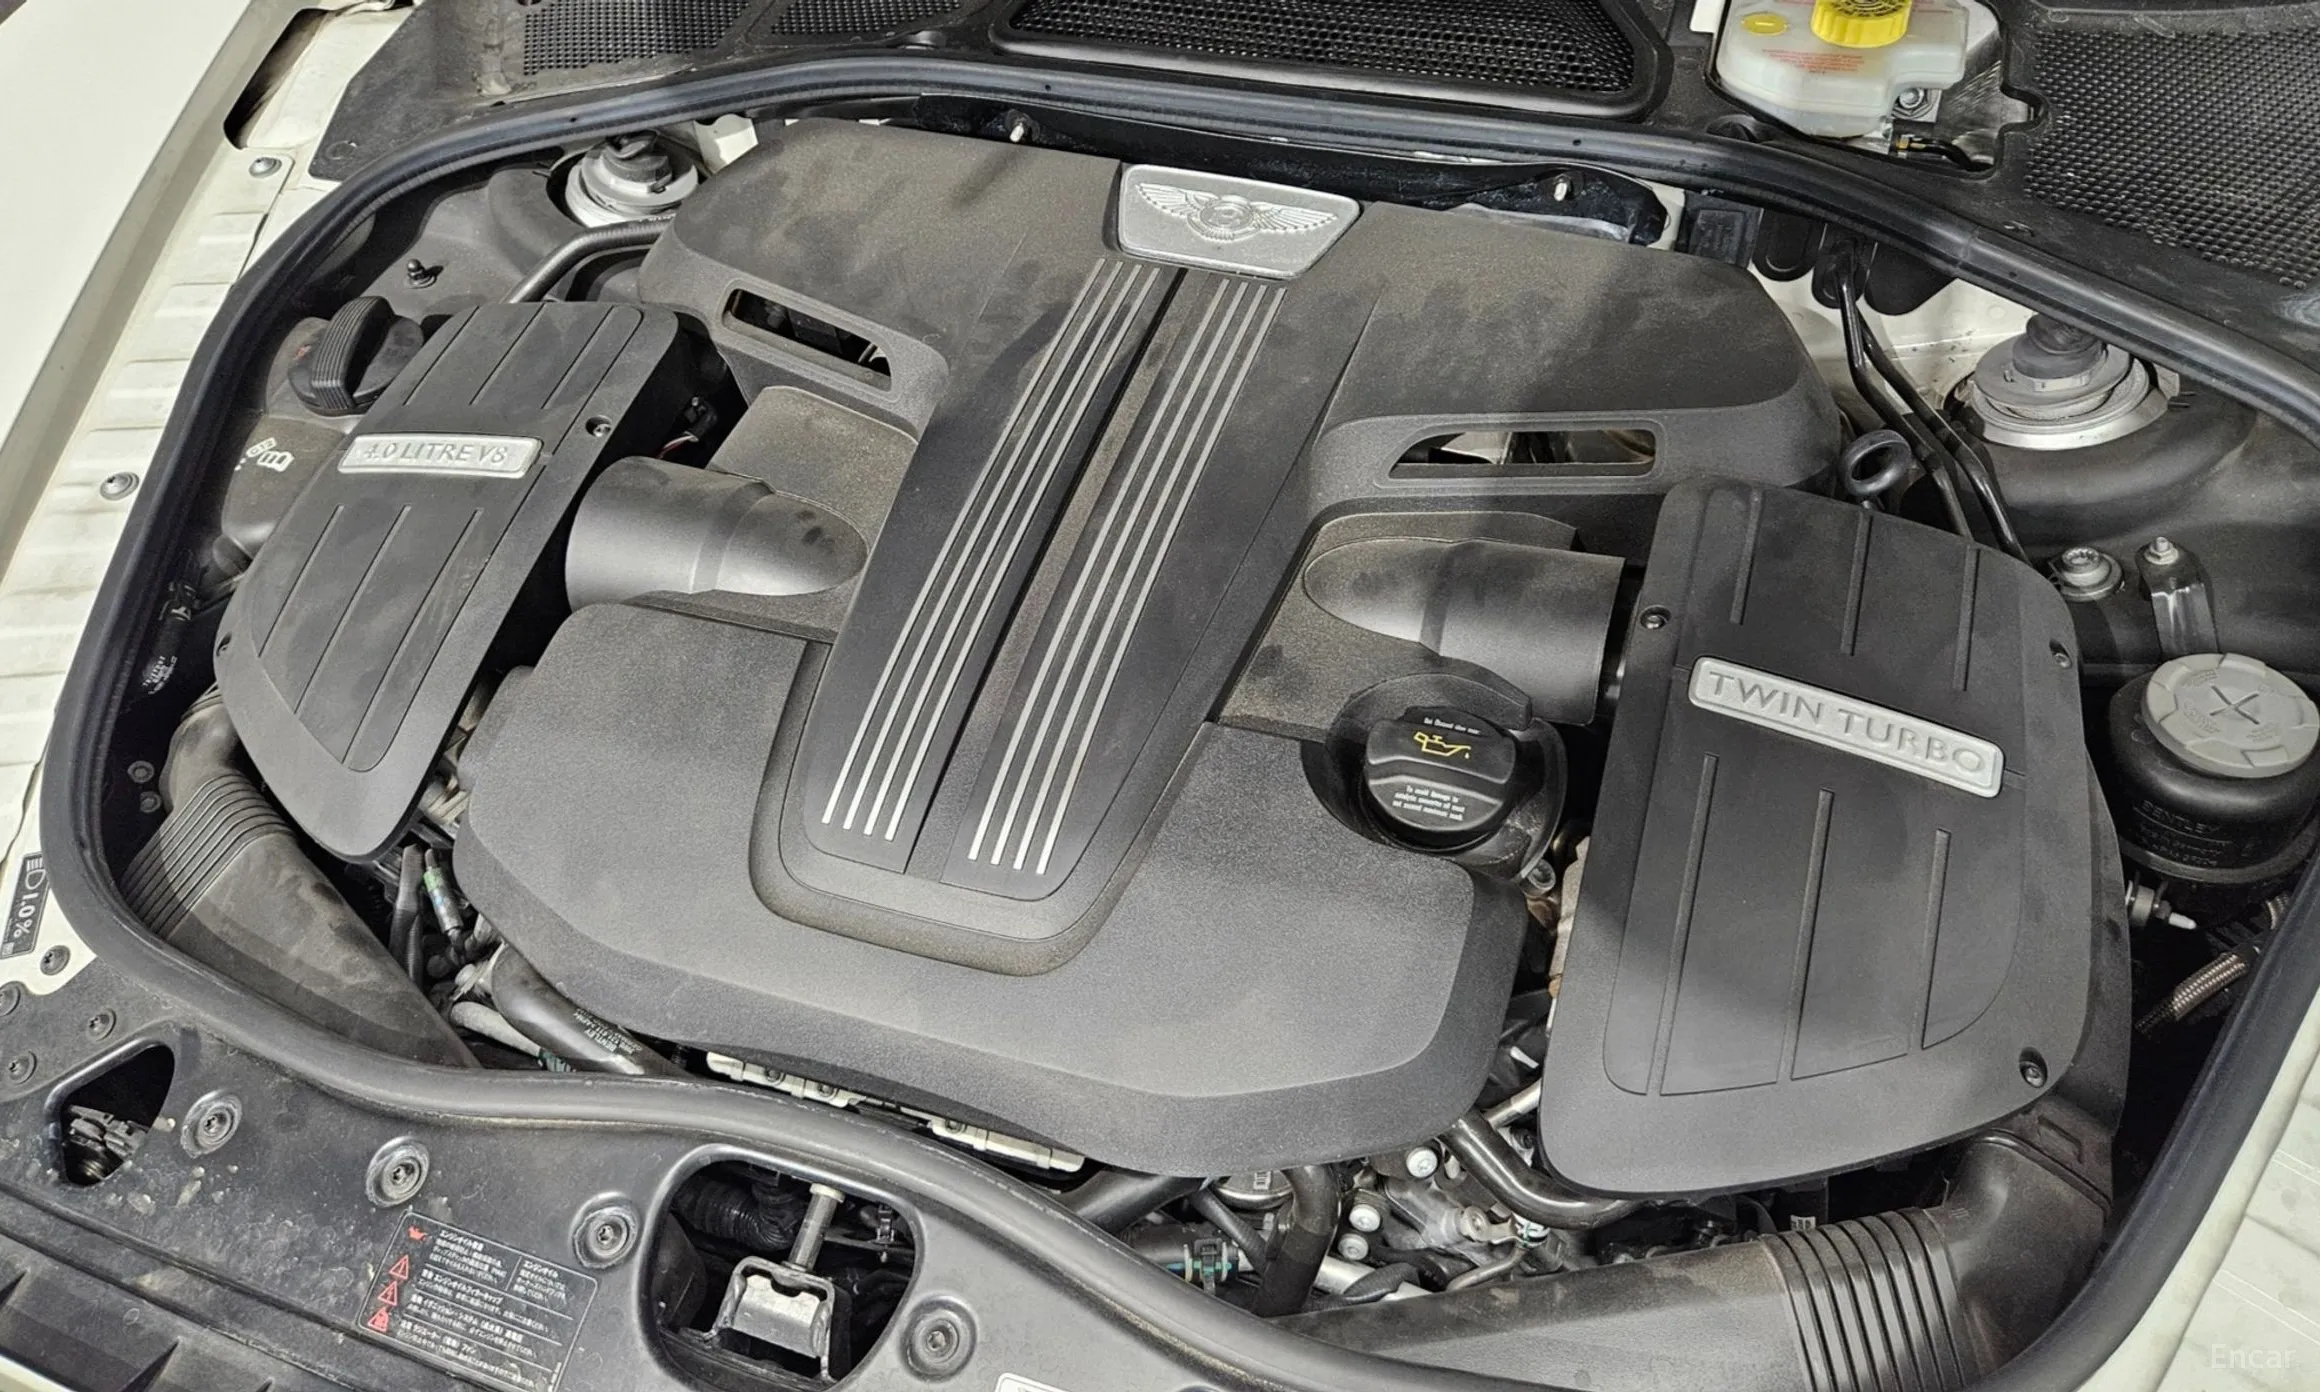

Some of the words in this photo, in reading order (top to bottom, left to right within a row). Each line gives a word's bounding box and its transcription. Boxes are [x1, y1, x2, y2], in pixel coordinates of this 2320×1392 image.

[364, 441, 397, 459] 4.0
[400, 442, 474, 462] LITRE
[478, 444, 508, 464] V8
[1709, 671, 1824, 726] TWIN
[1838, 708, 1985, 773] TURBO
